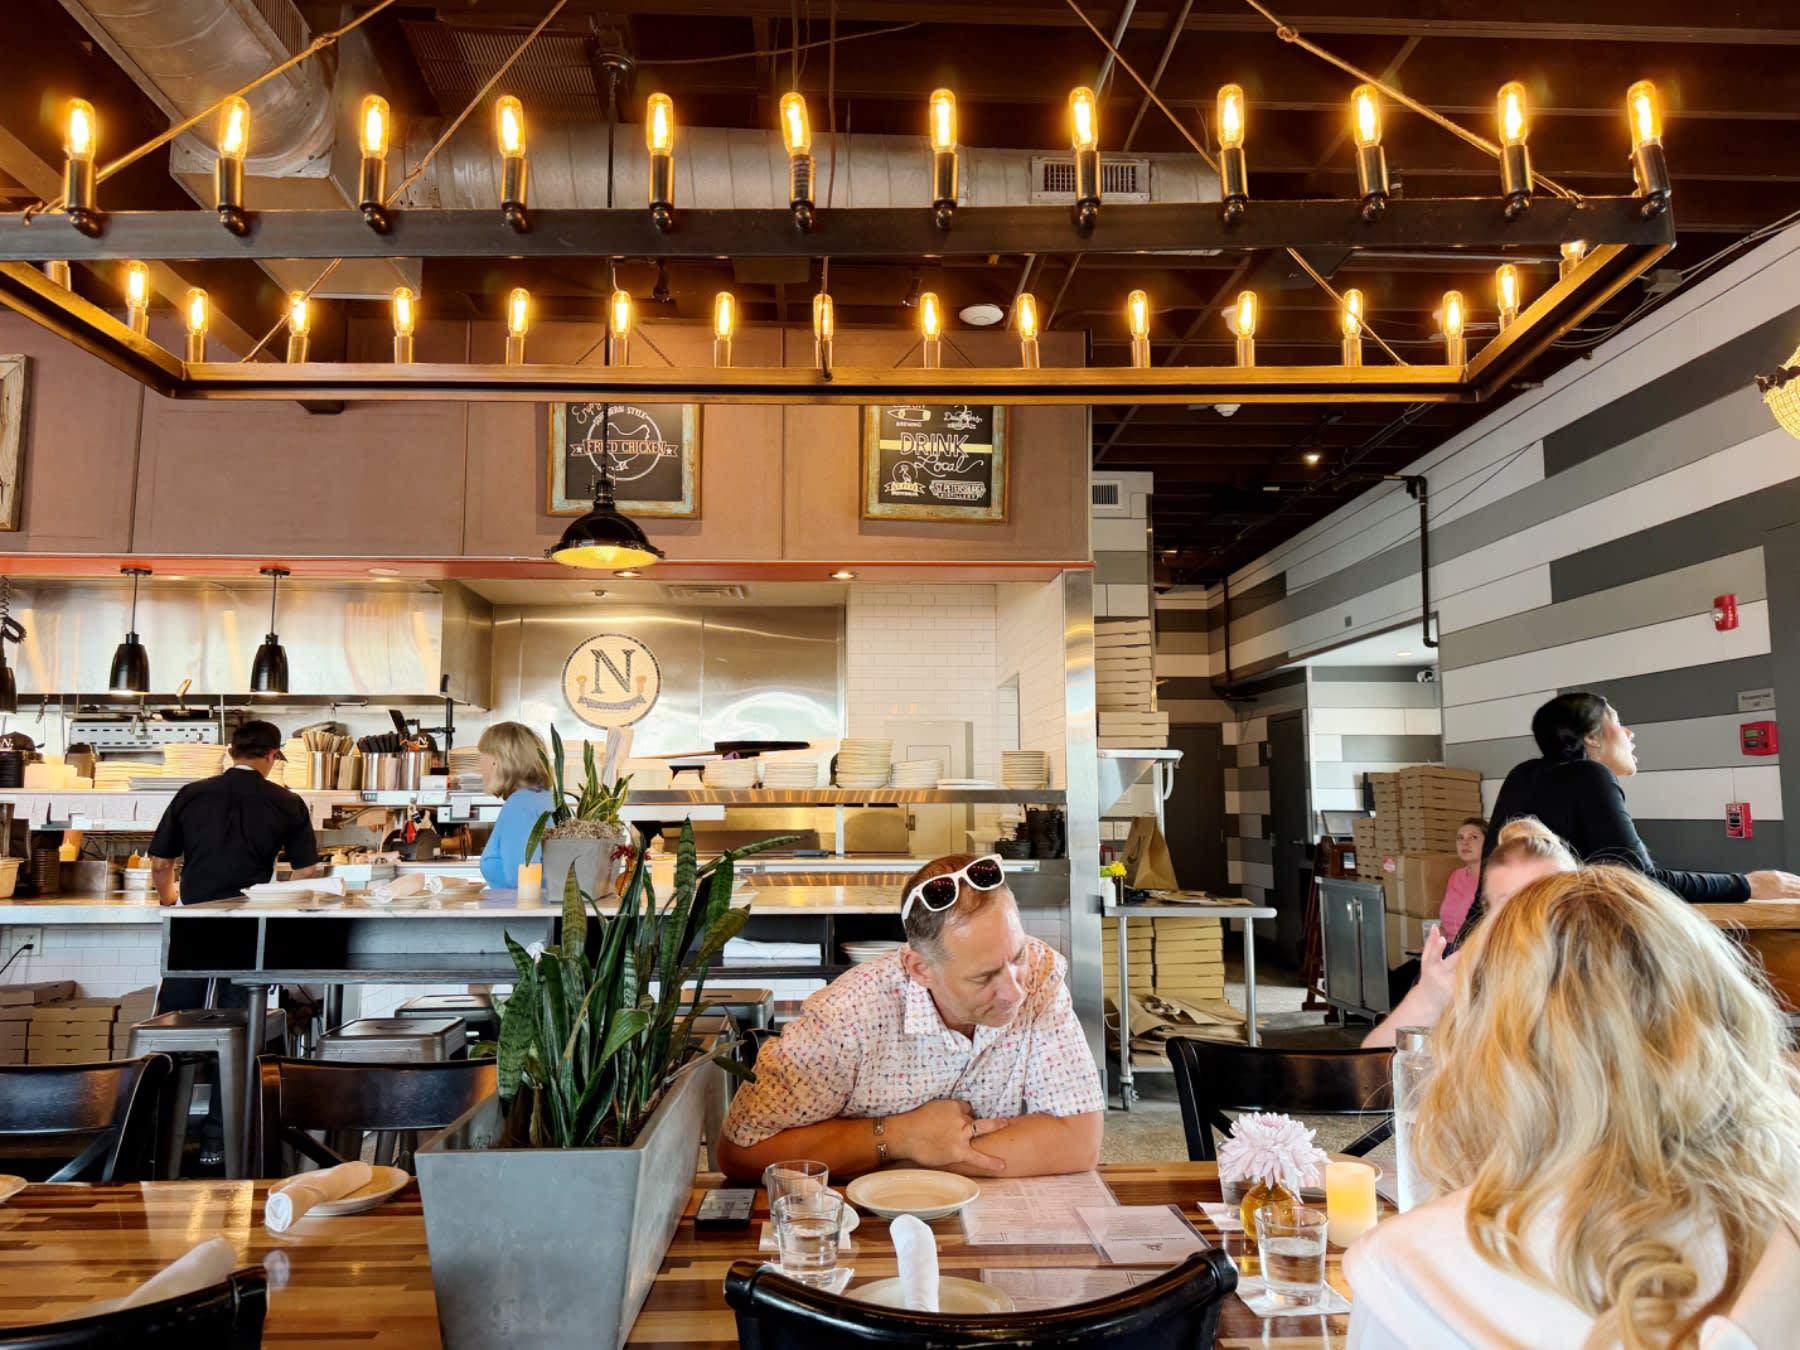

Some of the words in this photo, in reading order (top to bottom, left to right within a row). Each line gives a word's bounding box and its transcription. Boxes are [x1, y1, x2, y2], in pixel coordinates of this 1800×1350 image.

[621, 440, 665, 455] CHICKEN
[900, 431, 969, 458] DRINK
[913, 455, 984, 478] Local
[590, 648, 636, 694] N
